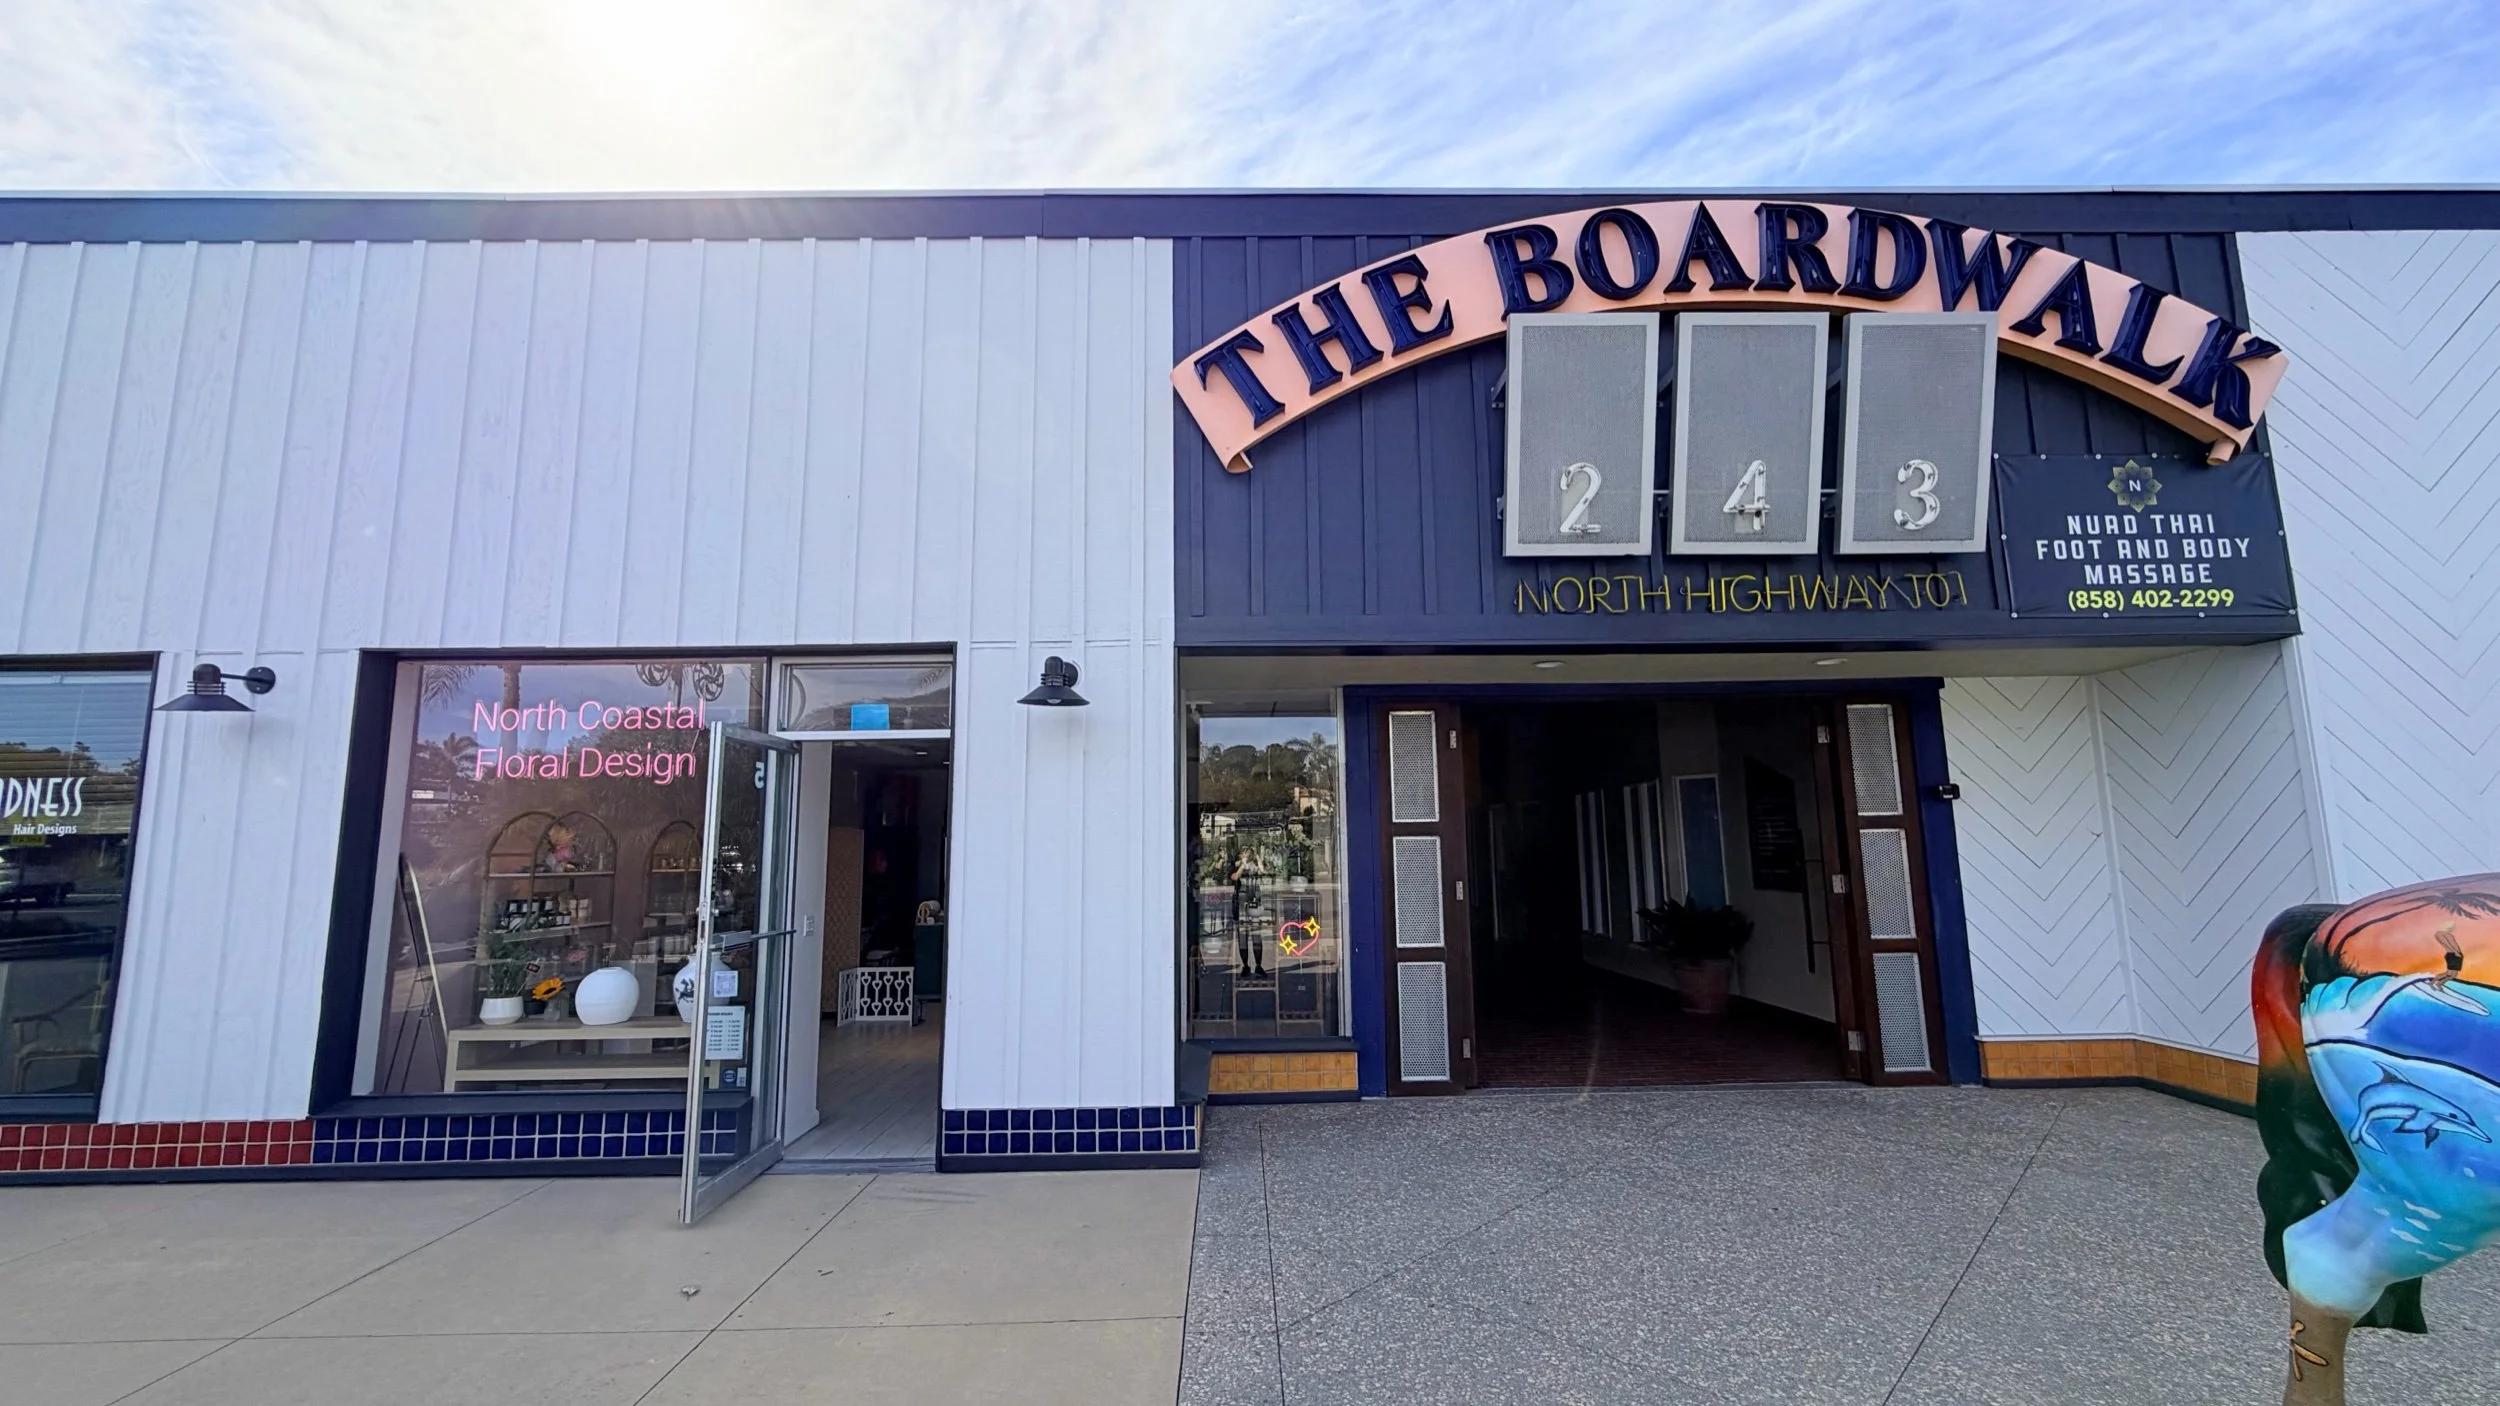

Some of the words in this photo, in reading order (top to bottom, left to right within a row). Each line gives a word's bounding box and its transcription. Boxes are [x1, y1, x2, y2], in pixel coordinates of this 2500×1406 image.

[1194, 253, 1454, 430] THE
[1484, 200, 2282, 430] BOARDWALK
[1560, 462, 1601, 533] 2
[1723, 459, 1771, 532] 4
[1893, 458, 1941, 531] 3
[2128, 479, 2142, 492] N
[2066, 514, 2138, 536] NUAD
[2150, 513, 2216, 535] THAI
[2036, 539, 2103, 560] FOOT
[2118, 538, 2170, 560] AND
[2182, 537, 2250, 559] BODY
[2084, 563, 2213, 585] MASSAGE
[1516, 574, 1671, 615] NORTH
[1686, 573, 1891, 613] HIGHWAY
[2068, 589, 2125, 612] (858)
[2131, 588, 2235, 609] 402-2299
[473, 700, 568, 733] North
[578, 698, 706, 731] Coastal
[475, 746, 569, 780] Floral
[578, 741, 696, 786] Design
[0, 776, 87, 818] DNESS
[13, 823, 36, 836] Hair
[36, 822, 78, 837] Designs
